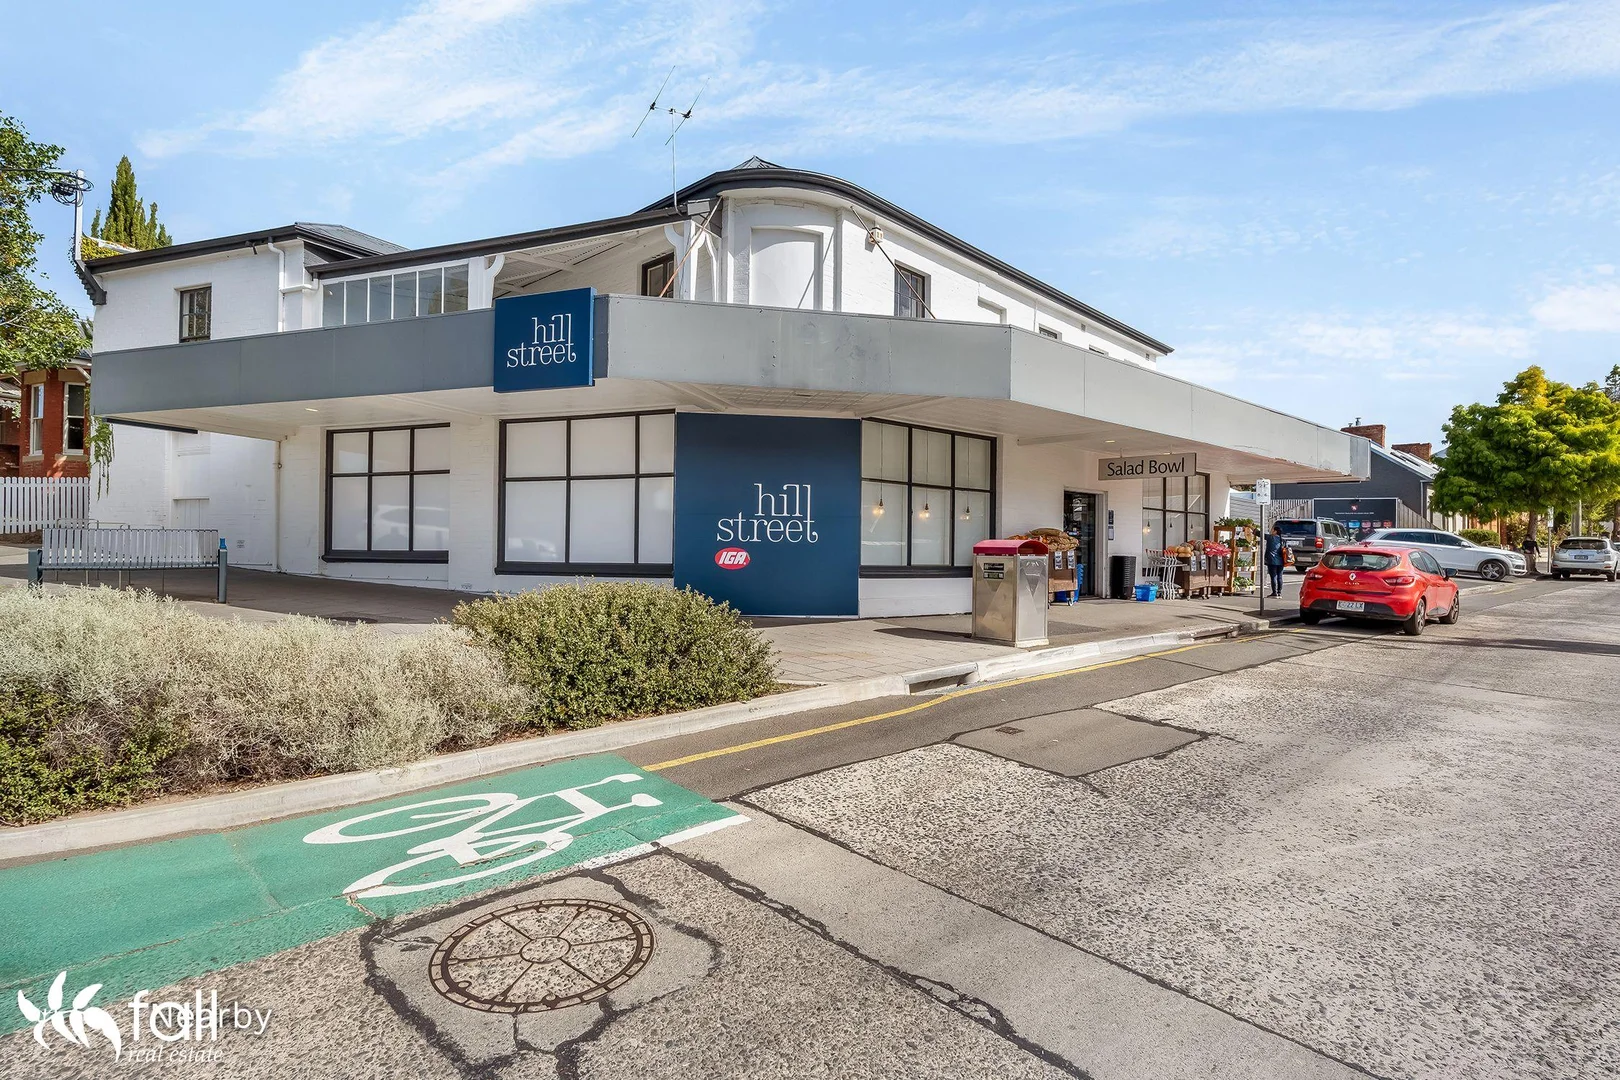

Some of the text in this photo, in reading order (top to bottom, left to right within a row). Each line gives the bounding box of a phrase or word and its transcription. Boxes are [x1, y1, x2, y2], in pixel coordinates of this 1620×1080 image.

[531, 313, 572, 345] hill
[506, 342, 577, 368] street
[1107, 457, 1185, 477] Salad Bowl
[754, 483, 812, 517] hill
[716, 511, 819, 544] street
[718, 551, 747, 565] IGA
